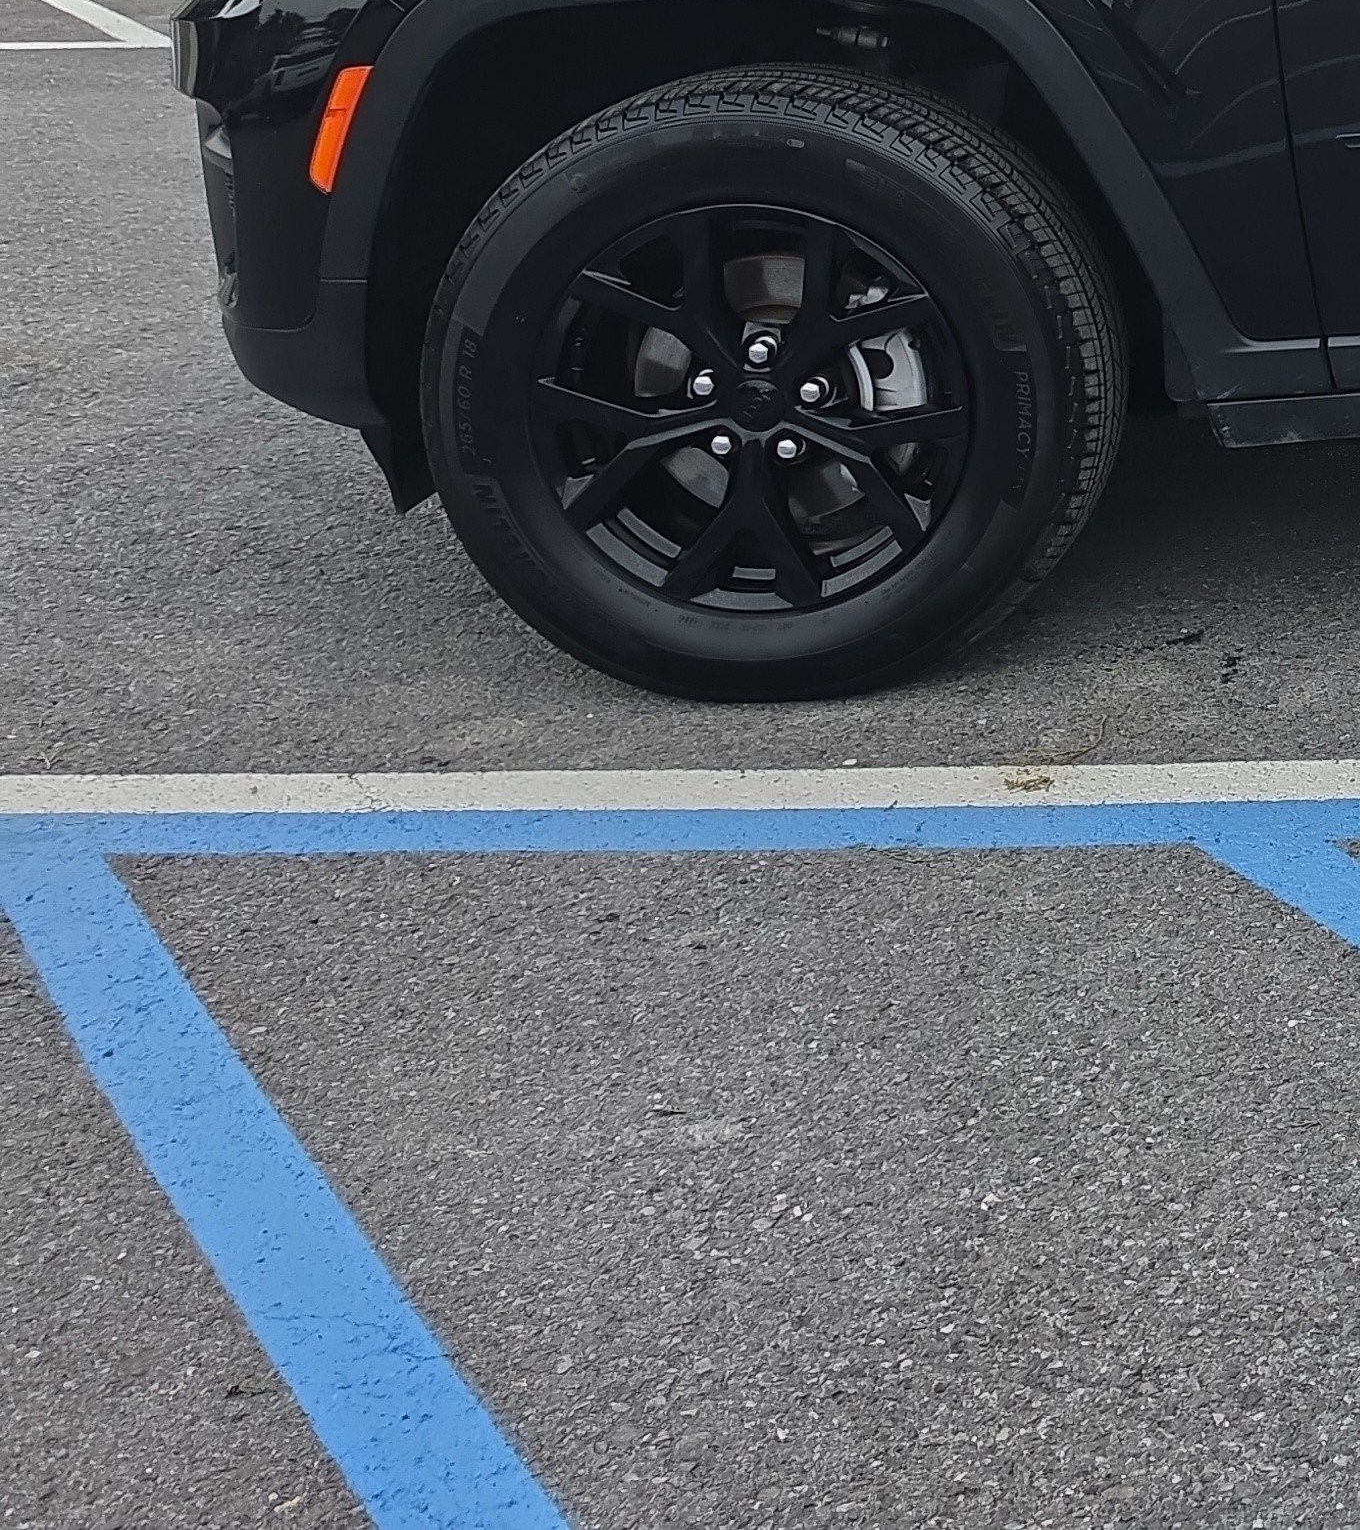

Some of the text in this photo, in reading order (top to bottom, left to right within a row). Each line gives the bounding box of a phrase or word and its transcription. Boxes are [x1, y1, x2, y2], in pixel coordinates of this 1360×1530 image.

[462, 338, 477, 358] 18
[457, 385, 477, 456] 265/60
[1013, 370, 1032, 460] PRIMACY
